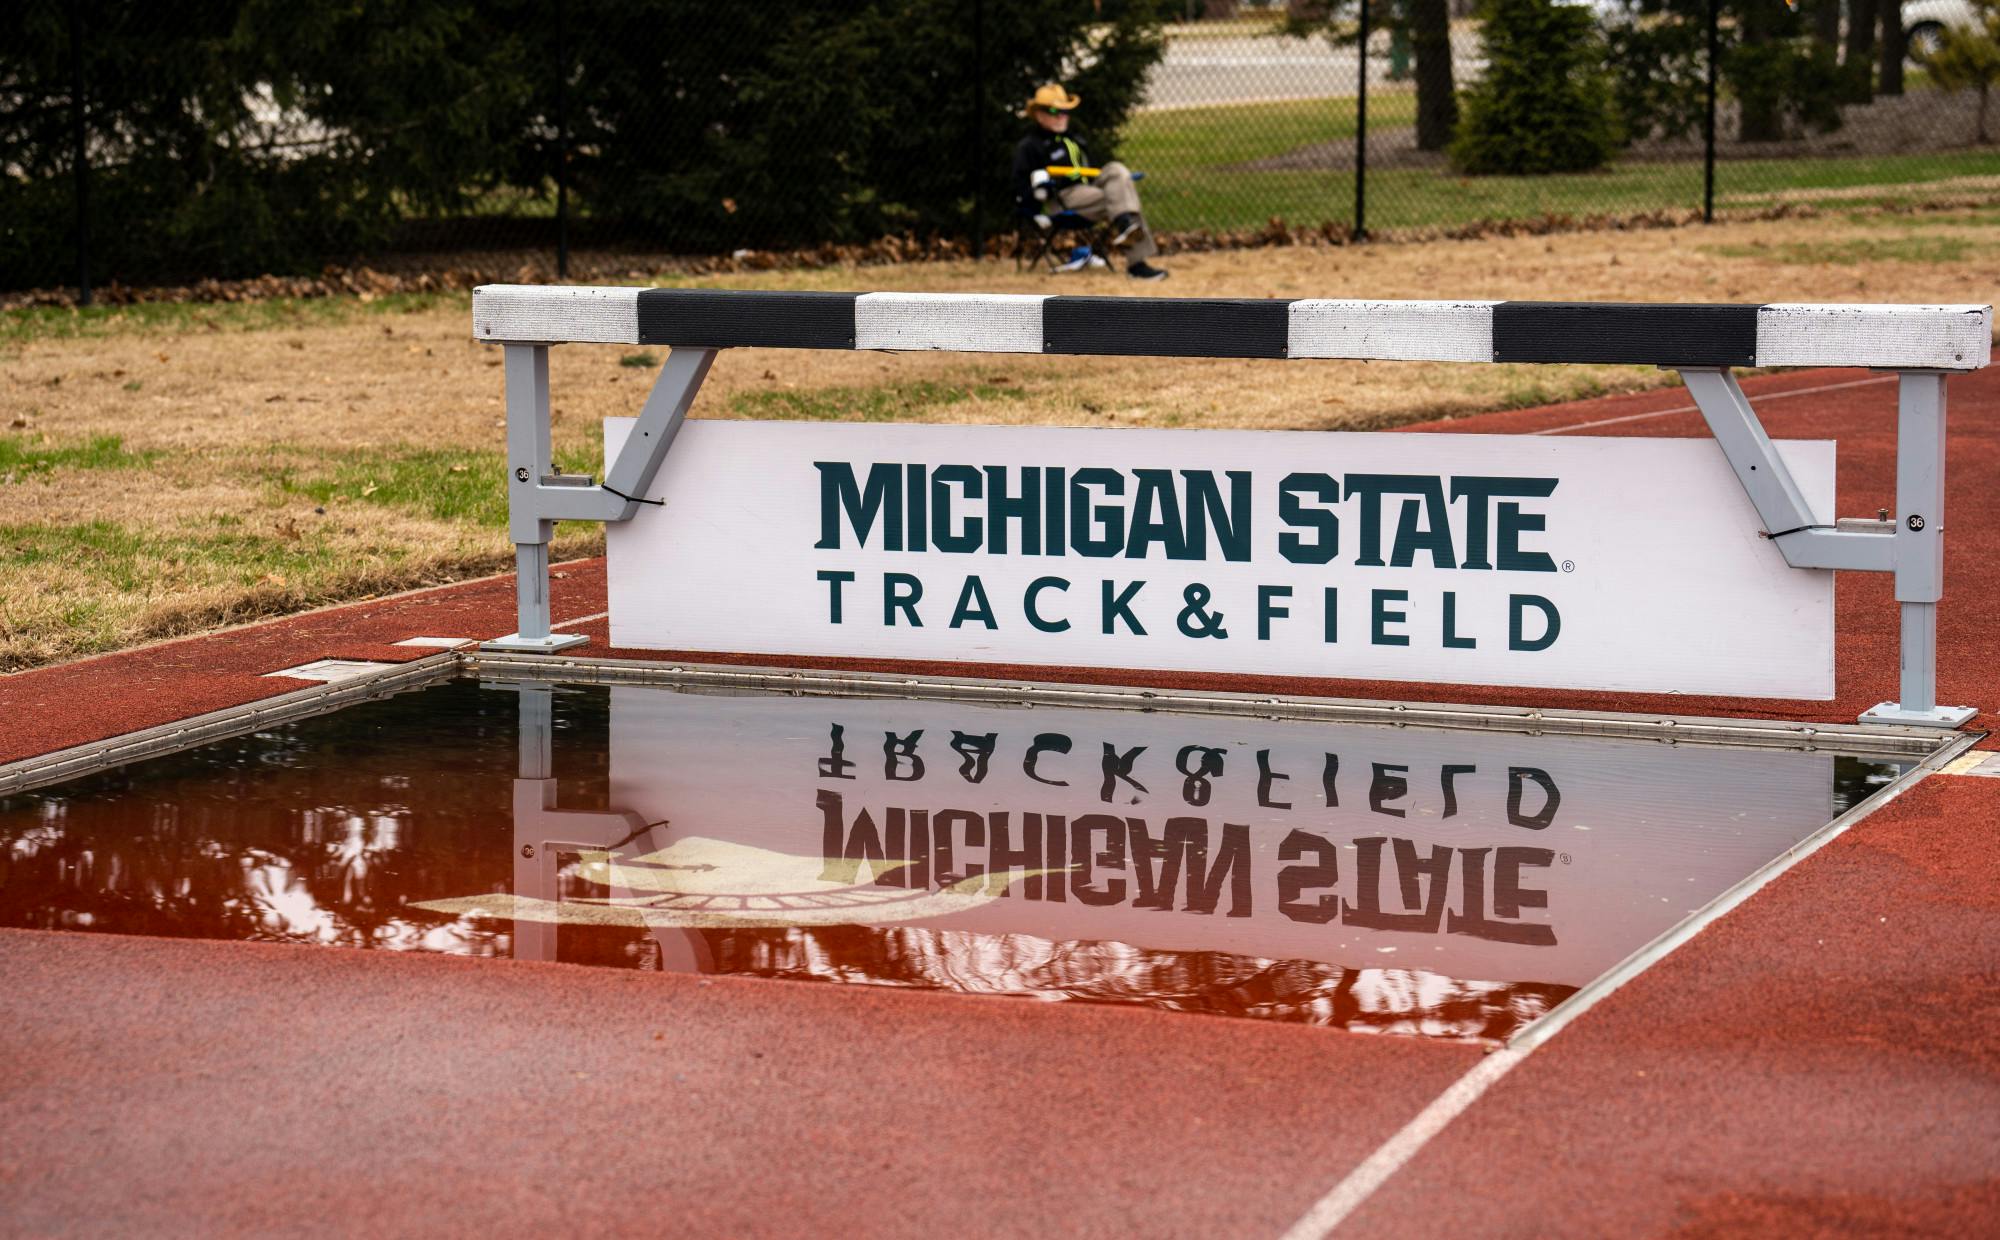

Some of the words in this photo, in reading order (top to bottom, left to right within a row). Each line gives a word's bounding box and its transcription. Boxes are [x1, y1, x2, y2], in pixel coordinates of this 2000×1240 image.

[519, 469, 529, 479] 36
[813, 461, 1252, 563] MICHIGAN
[1910, 517, 1924, 528] 36
